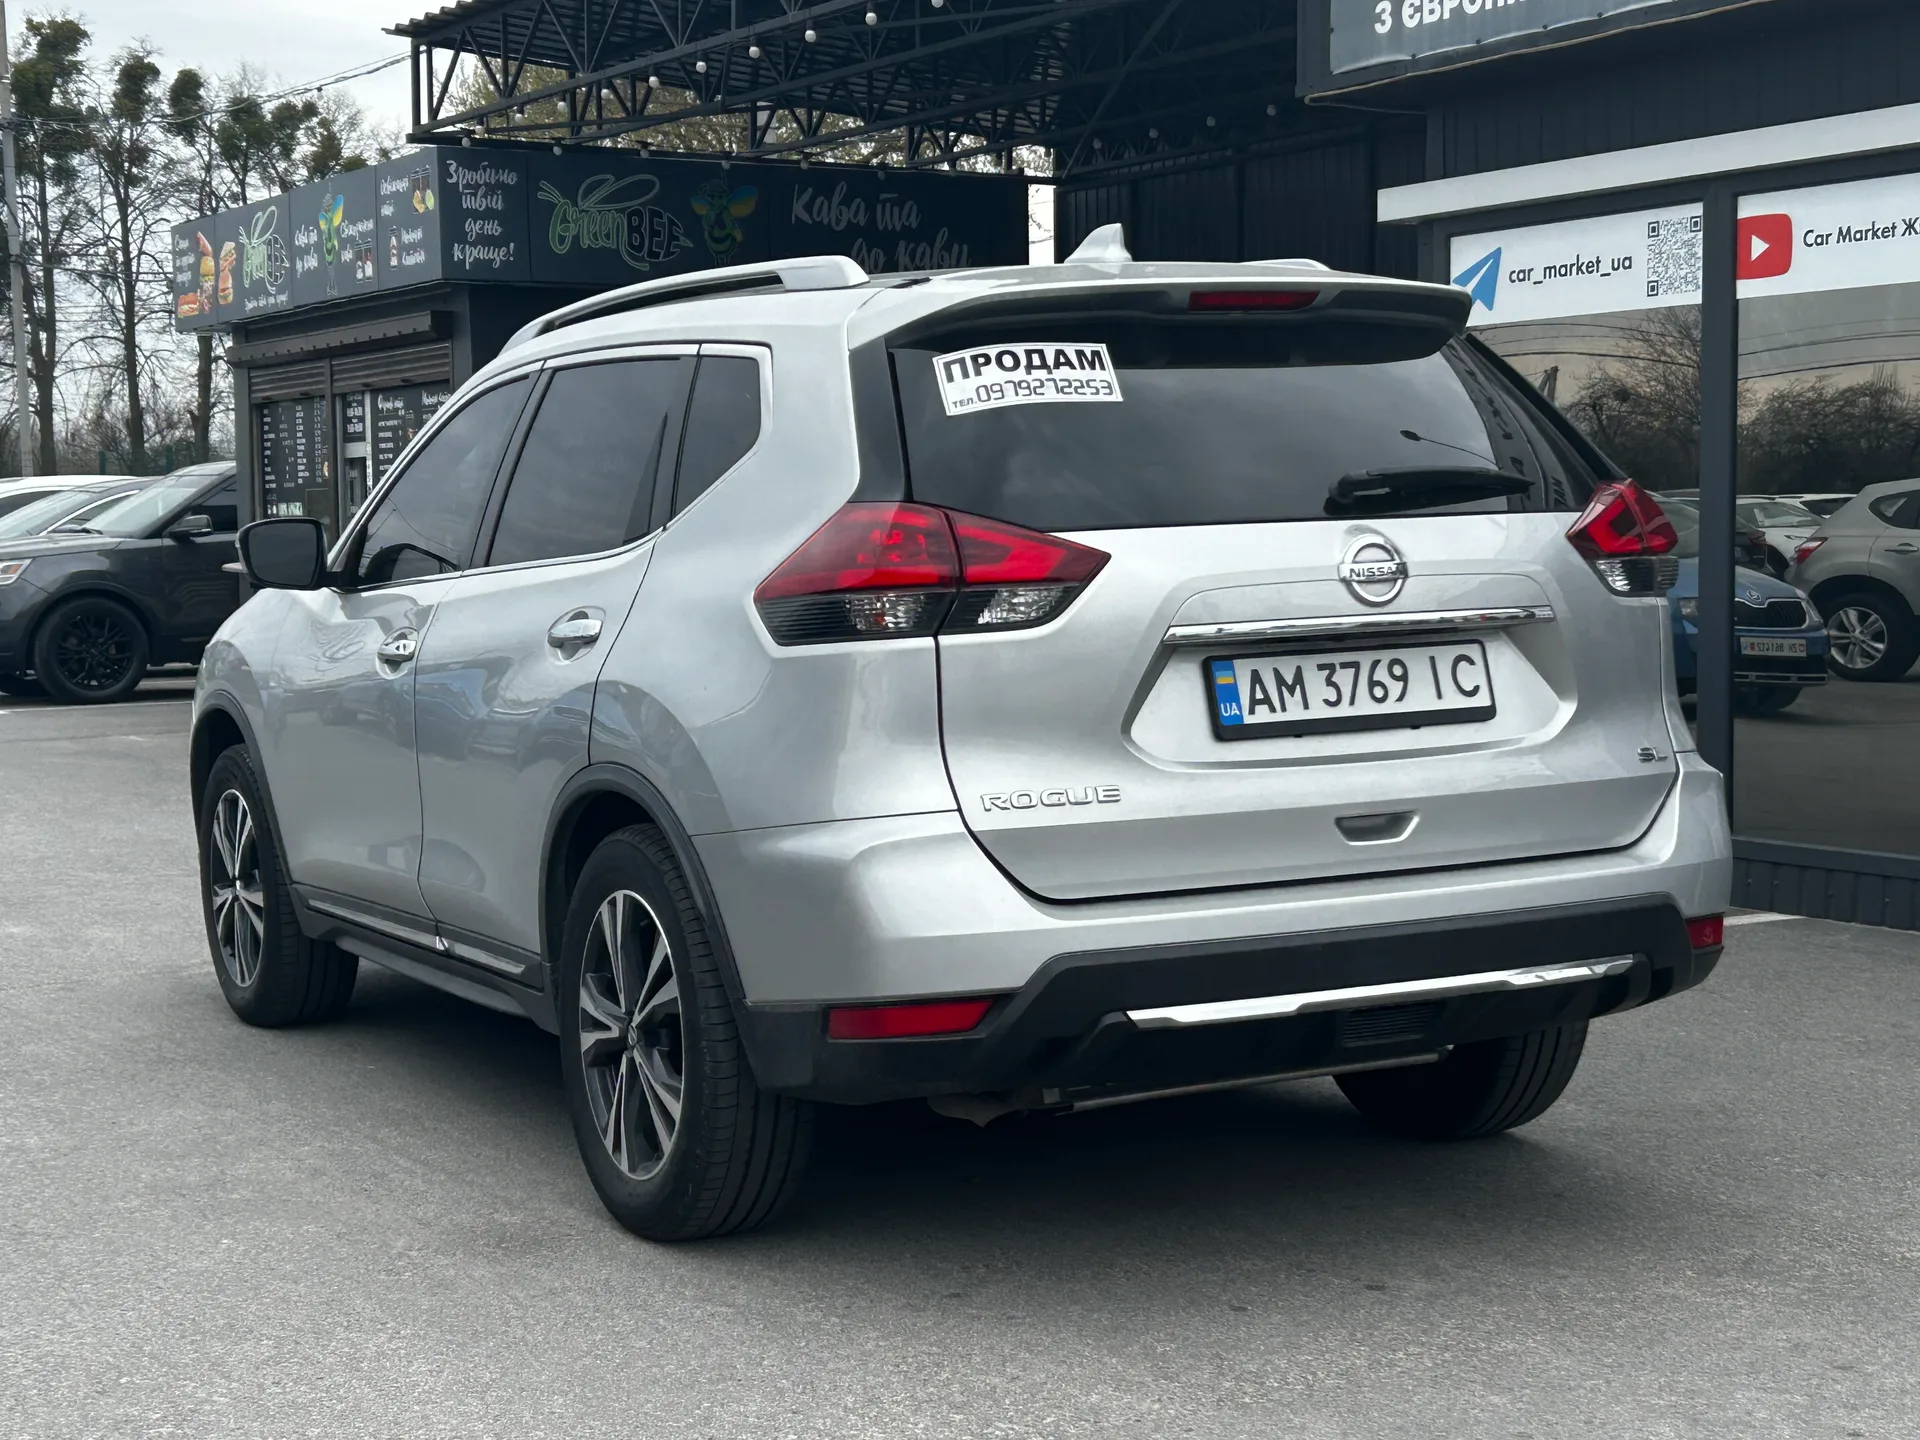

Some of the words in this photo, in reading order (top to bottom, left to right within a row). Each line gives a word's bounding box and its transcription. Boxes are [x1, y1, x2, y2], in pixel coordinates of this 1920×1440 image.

[1374, 1, 1394, 34] З
[446, 160, 518, 192] Зробимо
[461, 186, 504, 211] твій
[791, 181, 870, 231] Кава
[876, 193, 922, 232] та
[464, 218, 502, 241] день
[1803, 229, 1833, 248] Car
[1836, 220, 1898, 244] Market
[1901, 216, 1920, 237] Ж
[452, 242, 515, 270] краще!
[1508, 253, 1633, 285] car_market_ua
[942, 348, 1107, 384] ПРОДАМ
[975, 378, 1114, 403] 0979272253
[1349, 565, 1403, 579] NISSA
[1221, 703, 1240, 717] UA
[1248, 665, 1310, 716] AM
[1317, 657, 1409, 708] 3769
[1429, 653, 1481, 698] IC
[1637, 747, 1668, 763] SL
[980, 785, 1121, 812] ROGUE
